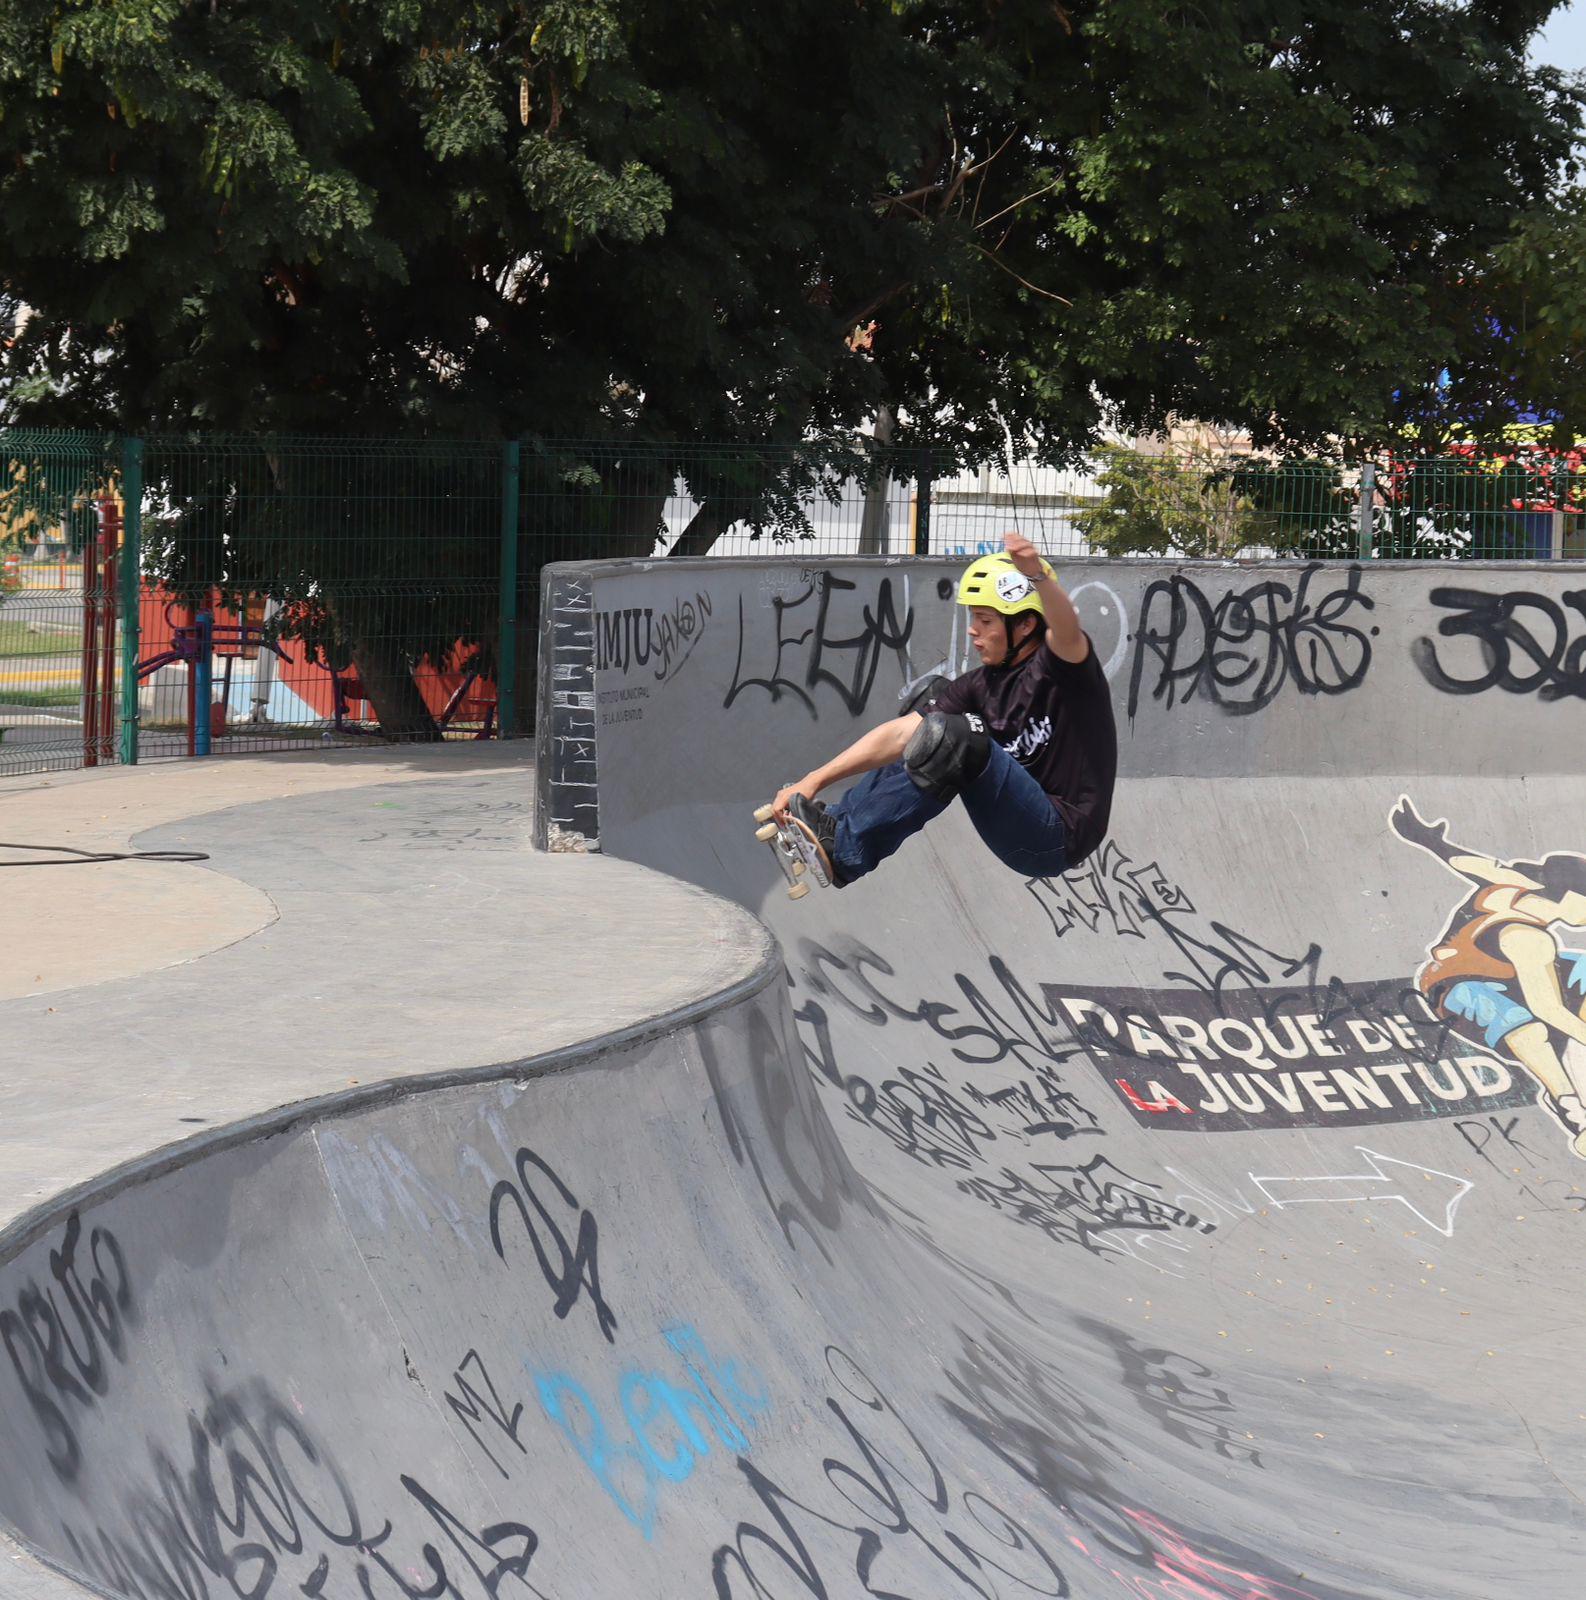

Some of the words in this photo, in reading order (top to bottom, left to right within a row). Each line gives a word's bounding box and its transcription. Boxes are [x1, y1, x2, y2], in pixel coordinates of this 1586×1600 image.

[595, 608, 653, 675] IMJU
[1060, 998, 1346, 1070] PARQUE
[1345, 1014, 1427, 1054] DE
[1114, 1078, 1196, 1114] LA
[1176, 1055, 1513, 1115] JUVENTUD
